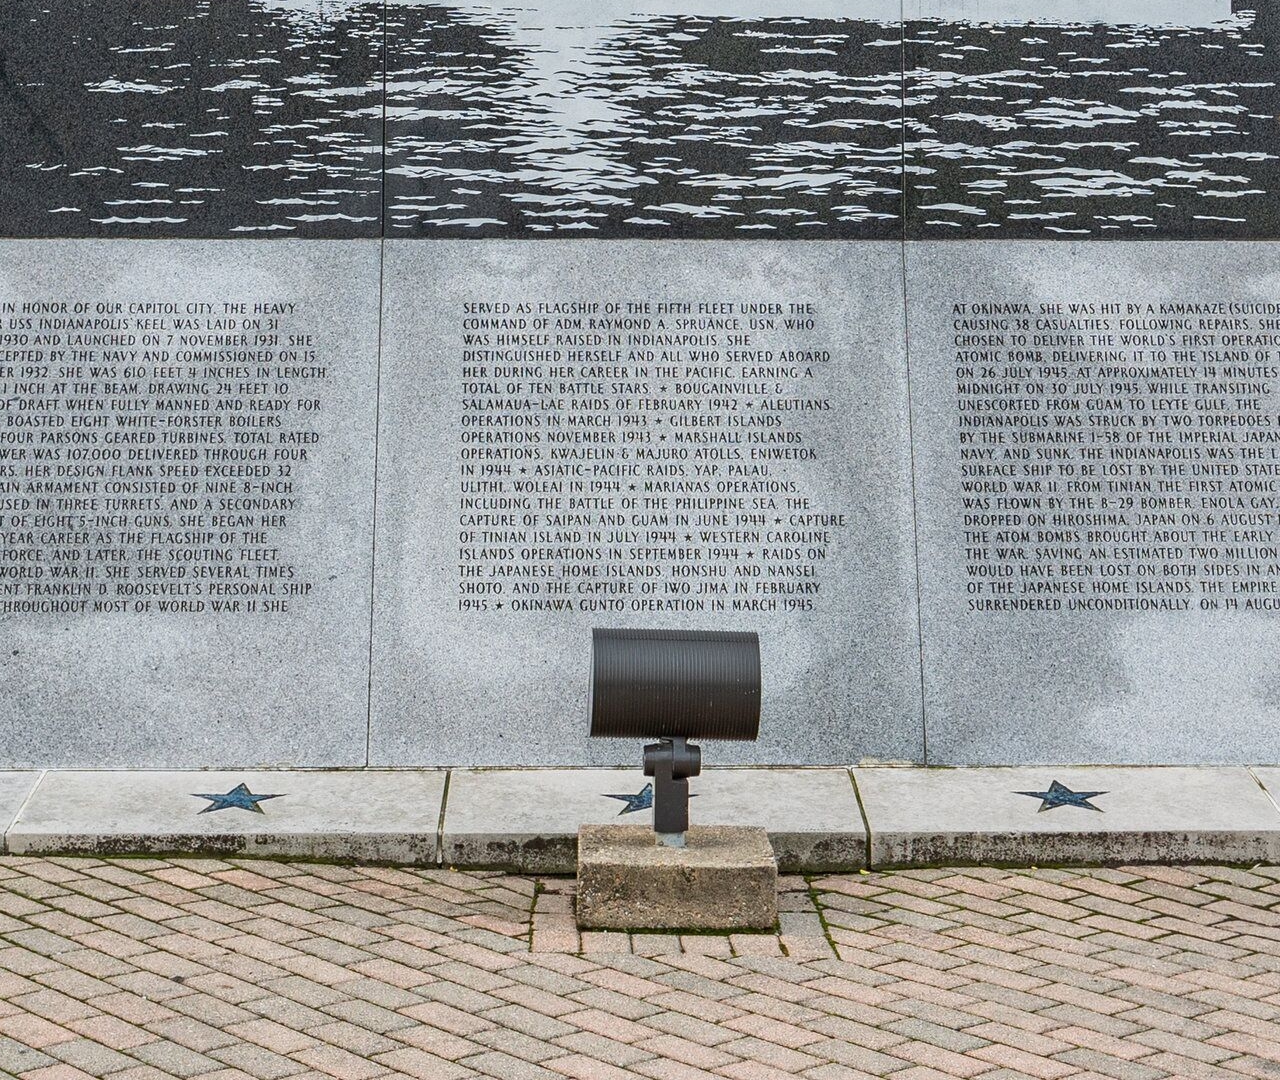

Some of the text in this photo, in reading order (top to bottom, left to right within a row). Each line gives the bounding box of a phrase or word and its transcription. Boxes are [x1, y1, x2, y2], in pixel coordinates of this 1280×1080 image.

[463, 301, 814, 314] SERVED AS FLAGSHIP OF THE FIFTH FLEET UNDER THE
[463, 333, 490, 346] WAS
[496, 333, 549, 346] HIMSELF
[555, 333, 602, 346] RAISED
[608, 333, 621, 346] IN
[726, 333, 750, 346] SHE
[954, 334, 1005, 347] CHOSEN
[1011, 333, 1028, 346] TO
[1034, 333, 1085, 346] DELIVER
[1091, 333, 1113, 346] THE
[1182, 333, 1215, 346] FIRST
[50, 350, 66, 363] BY
[72, 350, 96, 363] THE
[102, 350, 137, 363] NAVY
[143, 350, 170, 363] AND
[176, 350, 274, 363] COMMISSIONED
[279, 350, 298, 363] ON
[304, 350, 316, 363] 15
[462, 349, 831, 362] DISTINGUISHED HERSELF AND ALL WHO SERVED ABOARD
[571, 398, 610, 411] RAIDS
[616, 398, 631, 411] OF
[637, 398, 701, 411] FEBRUARY
[707, 398, 739, 411] 1942
[760, 398, 831, 411] ALEUTIANS
[6, 414, 65, 427] BOASTED
[71, 414, 109, 427] EIGHT
[229, 414, 282, 427] BOILERS
[461, 414, 783, 427] OPERATIONS IN MARCH 1943 GILBERT ISLANDS
[960, 414, 1049, 427] INDIANAPOLIS
[1055, 414, 1082, 427] WAS
[1088, 414, 1136, 427] STRUCK
[1142, 414, 1157, 427] BY
[1163, 414, 1193, 427] TWO
[1199, 414, 1271, 427] TORPEDOES
[461, 431, 803, 444] OPERATIONS NOVEMBER 1943 MARSHALL ISLANDS
[959, 431, 975, 444] BY
[981, 431, 1006, 444] THE
[1012, 430, 1085, 443] SUBMARINE
[1126, 430, 1142, 443] OF
[1148, 430, 1173, 443] THE
[1179, 430, 1236, 443] IMPERIAL
[961, 464, 1016, 477] SURFACE
[1022, 463, 1053, 476] SHIP
[1059, 463, 1075, 476] TO
[1081, 463, 1096, 476] BE
[1102, 463, 1133, 476] LOST
[1139, 463, 1155, 476] BY
[1161, 463, 1186, 476] THE
[1192, 463, 1239, 476] UNITED
[26, 481, 98, 494] ARMAMENT
[104, 481, 176, 494] CONSISTED
[182, 481, 198, 494] OF
[204, 481, 238, 494] NINE
[11, 514, 29, 527] OF
[35, 514, 74, 527] EIGHT
[180, 514, 205, 527] SHE
[211, 514, 255, 527] BEGAN
[261, 514, 287, 527] HER
[459, 513, 845, 526] CAPTURE OF SAIPAN AND GUAM IN JUNE 1944 CAPTURE
[0, 531, 36, 544] YEAR
[39, 531, 91, 544] CAREER
[95, 531, 113, 544] AS
[119, 531, 144, 544] THE
[150, 531, 215, 544] FLAGSHIP
[219, 531, 238, 544] OF
[241, 531, 268, 544] THE
[459, 547, 827, 560] ISLANDS OPERATIONS IN SEPTEMBER 1944 RAIDS ON
[966, 564, 1014, 577] WOULD
[1020, 563, 1055, 576] HAVE
[1061, 563, 1093, 576] BEEN
[1099, 563, 1131, 576] LOST
[1137, 563, 1157, 576] ON
[1163, 563, 1198, 576] BOTH
[1204, 563, 1240, 576] SIDES
[1246, 563, 1261, 576] IN
[26, 582, 92, 595] FRANKLIN
[209, 582, 276, 595] PERSONAL
[282, 582, 313, 595] SHIP
